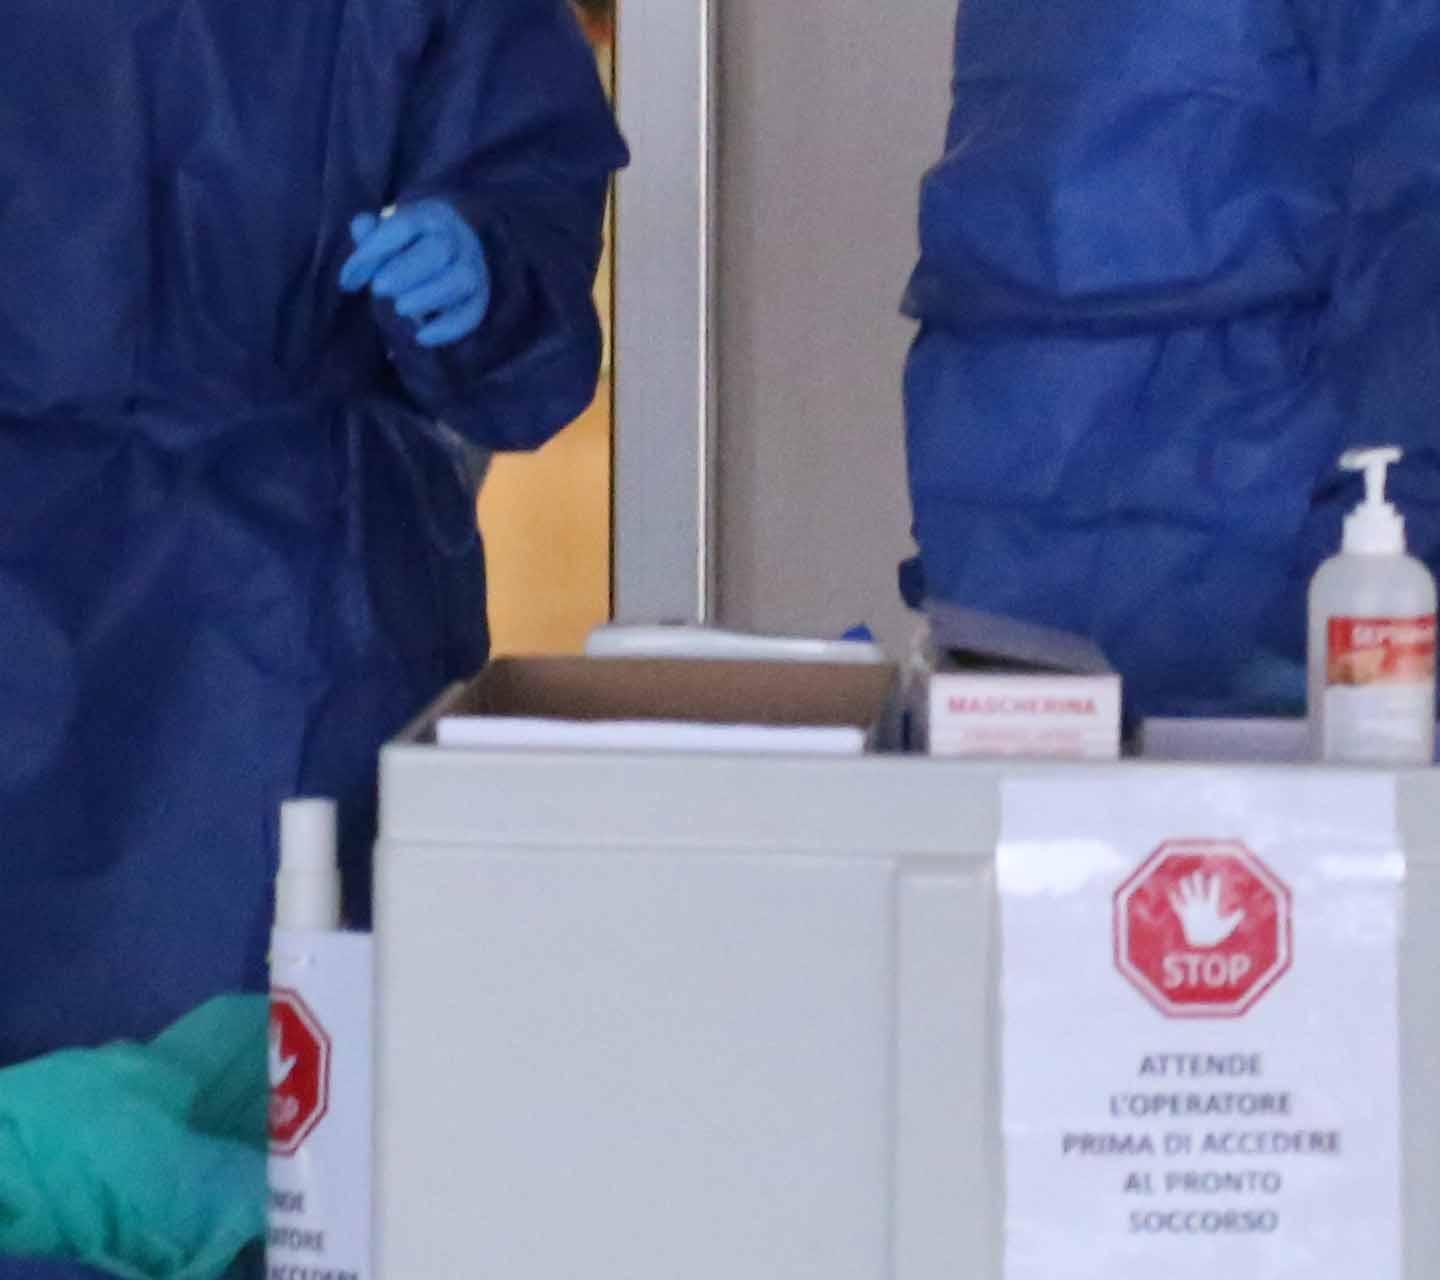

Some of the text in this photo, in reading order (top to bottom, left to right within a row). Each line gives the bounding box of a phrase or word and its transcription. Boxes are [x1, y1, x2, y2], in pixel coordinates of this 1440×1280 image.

[1161, 954, 1252, 989] STOP
[1137, 1053, 1262, 1078] ATTENDE
[1110, 1093, 1293, 1117] L'OPERATORE
[1061, 1130, 1342, 1157] PRIMA DI ACCEDERE
[1122, 1170, 1283, 1196] AL PRONTO
[1128, 1210, 1280, 1236] SOCCORSO
